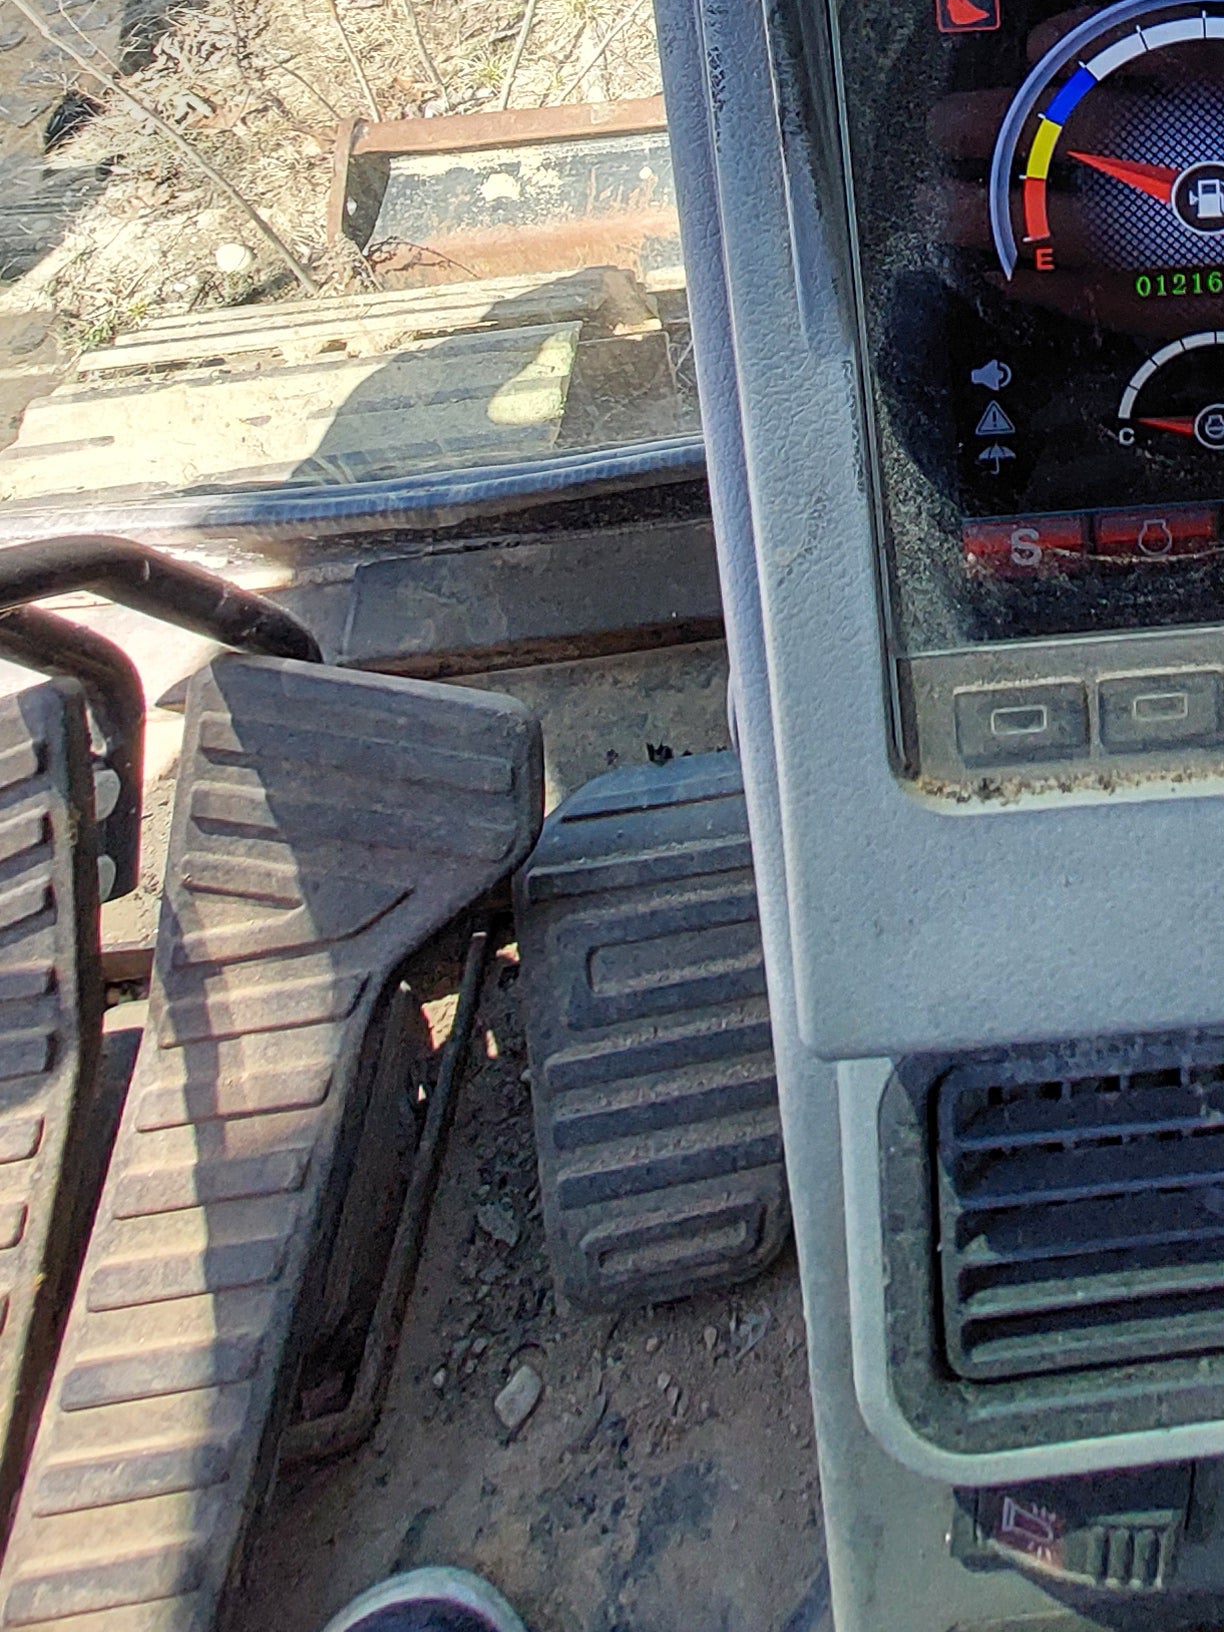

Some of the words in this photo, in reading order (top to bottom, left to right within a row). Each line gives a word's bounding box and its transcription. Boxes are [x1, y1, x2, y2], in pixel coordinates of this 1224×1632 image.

[1036, 248, 1055, 271] E
[1118, 427, 1136, 446] C
[1010, 528, 1043, 566] S
